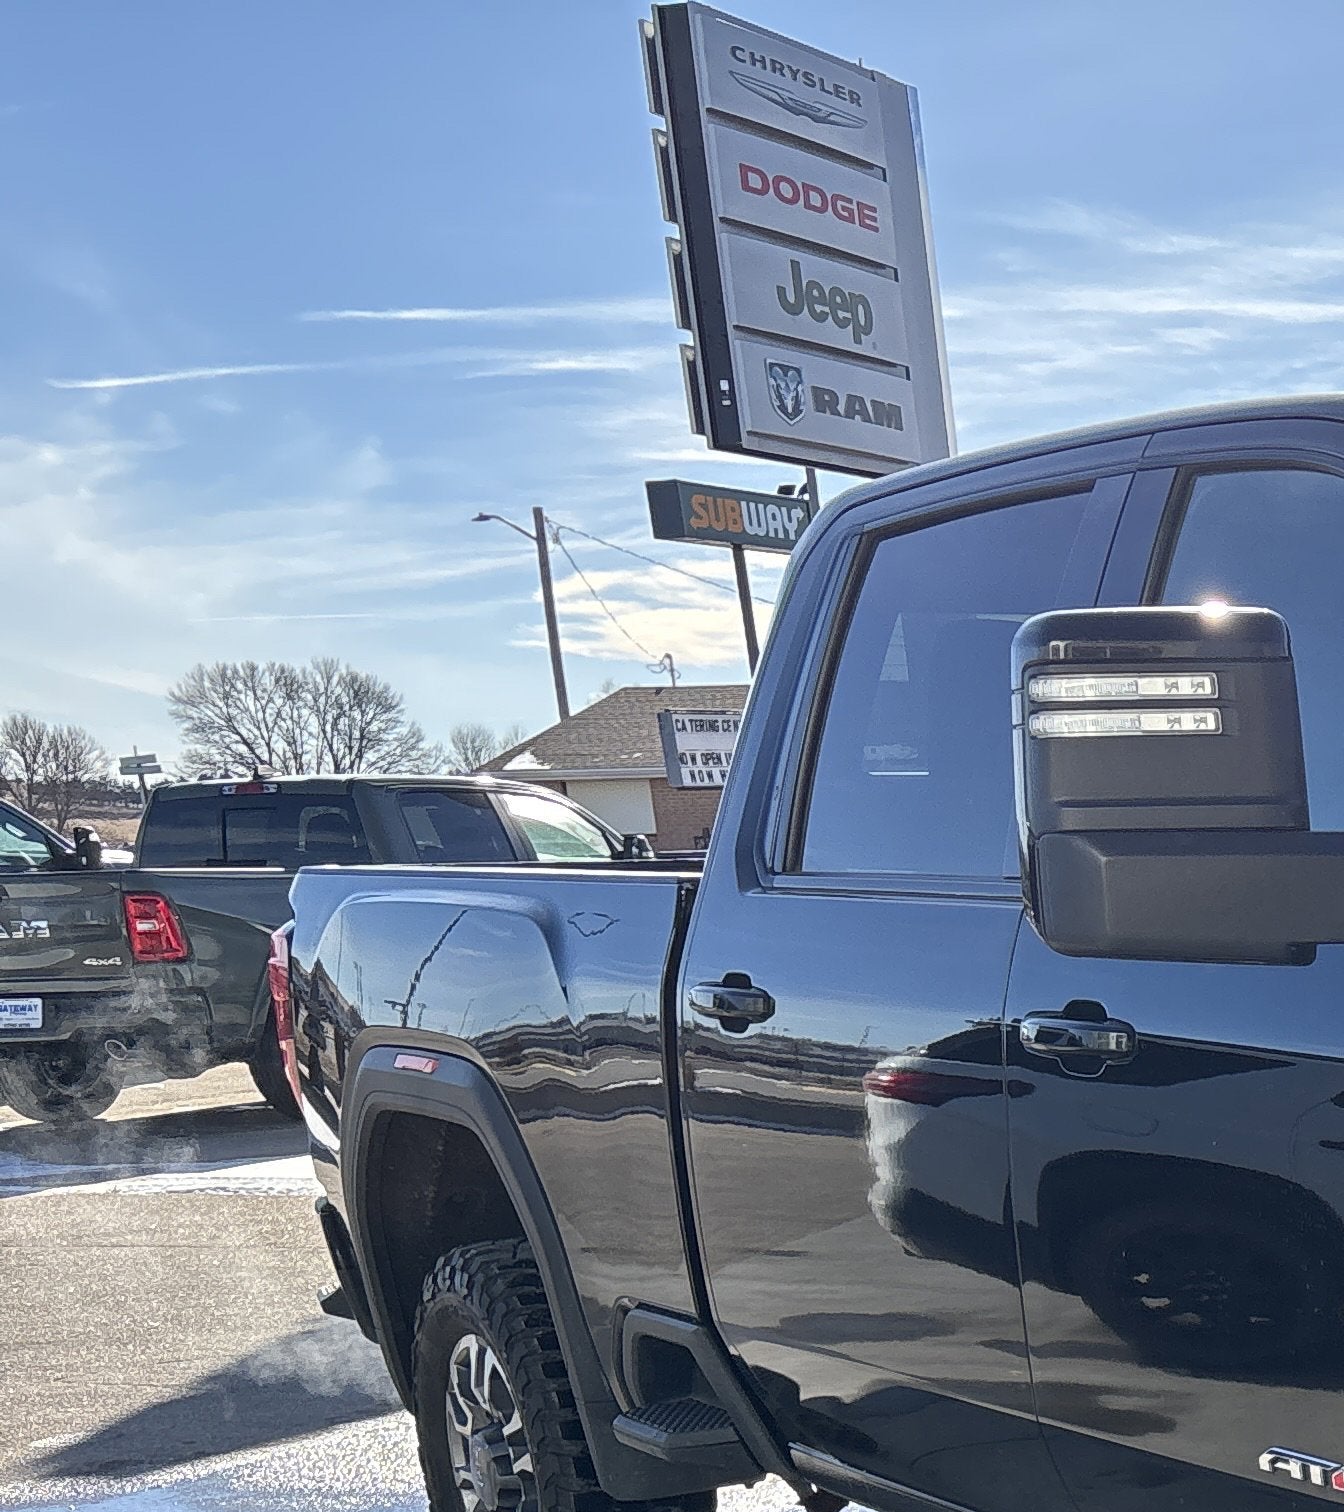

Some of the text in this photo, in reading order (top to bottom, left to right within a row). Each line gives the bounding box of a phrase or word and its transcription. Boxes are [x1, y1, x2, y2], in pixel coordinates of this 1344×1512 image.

[729, 45, 863, 108] CHRYSLER
[739, 162, 880, 233] DODGE
[776, 259, 874, 345] Jeep
[810, 385, 904, 432] RAM
[689, 493, 805, 541] SUBWAY
